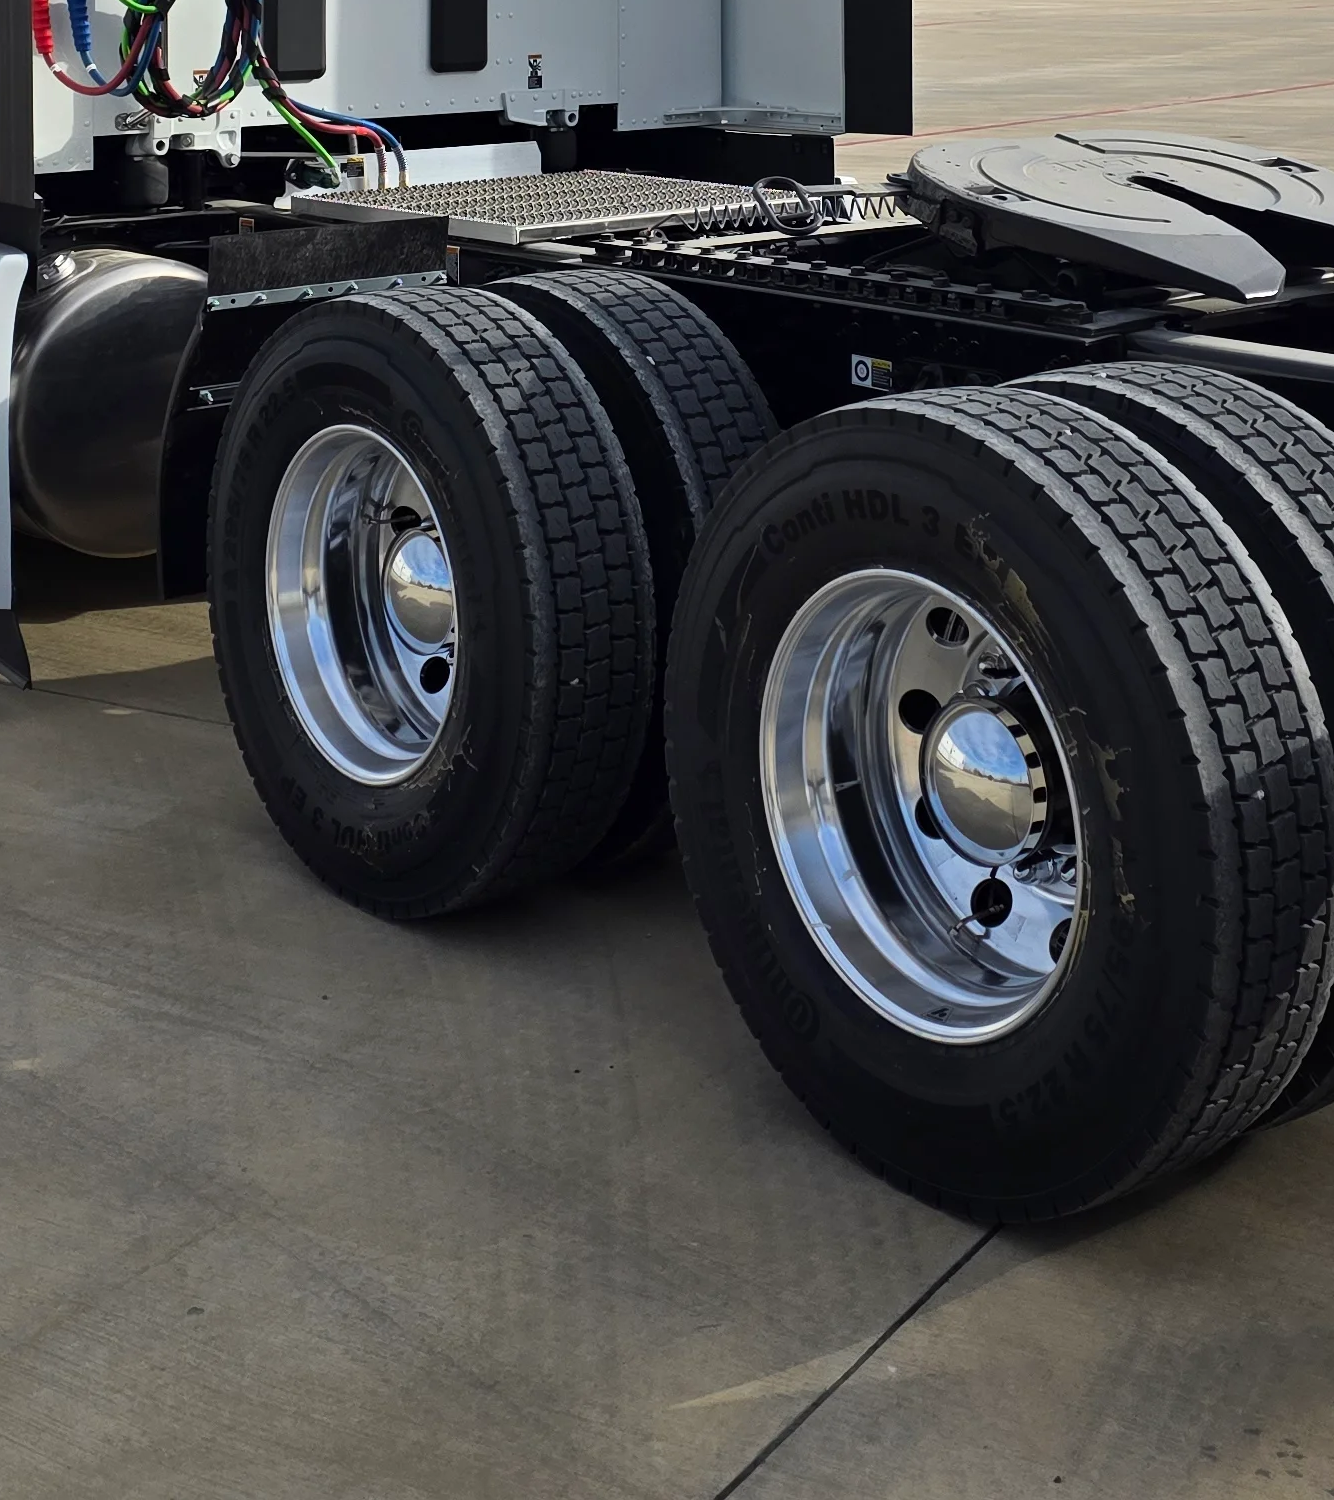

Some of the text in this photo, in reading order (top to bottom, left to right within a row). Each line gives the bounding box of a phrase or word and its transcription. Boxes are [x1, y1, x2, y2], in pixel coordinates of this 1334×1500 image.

[761, 490, 836, 556] Conti
[841, 488, 910, 527] HDL
[920, 505, 940, 538] 3
